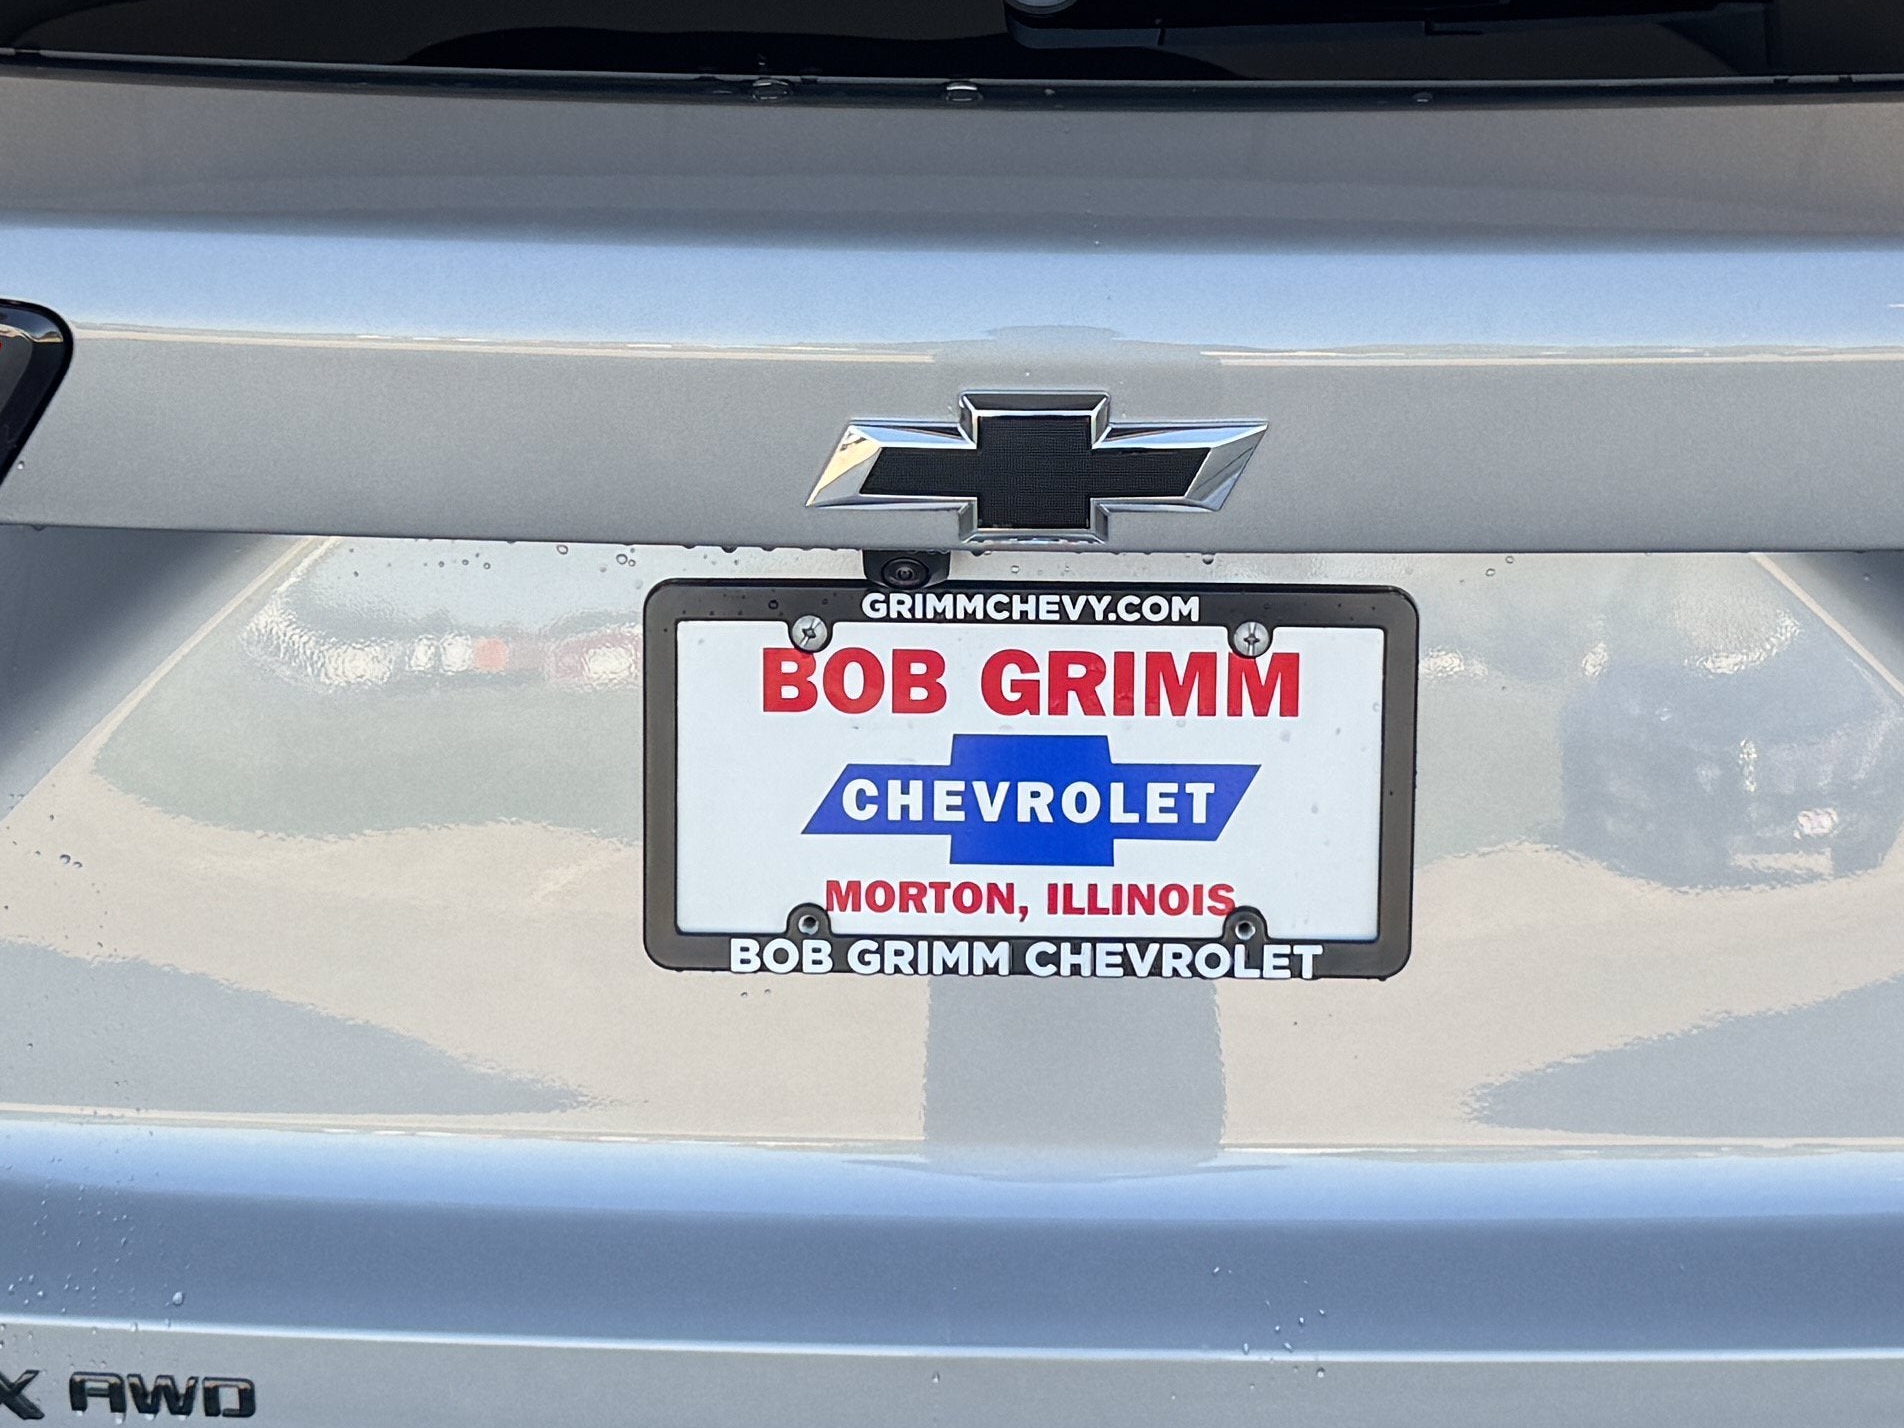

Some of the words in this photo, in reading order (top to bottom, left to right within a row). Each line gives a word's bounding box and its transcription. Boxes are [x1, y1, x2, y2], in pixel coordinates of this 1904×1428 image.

[862, 592, 1201, 624] GRIMMCHEVY.COM
[762, 646, 947, 716] BOB
[981, 649, 1300, 718] GRIMM
[841, 778, 1216, 825] CHEVROLET
[825, 880, 1029, 922] MORTON,
[1047, 882, 1236, 918] ILLINOIS
[729, 939, 832, 974] BOB
[847, 940, 1010, 977] GRIMM
[1025, 942, 1324, 981] CHEVROLET
[69, 1370, 258, 1419] AWD
